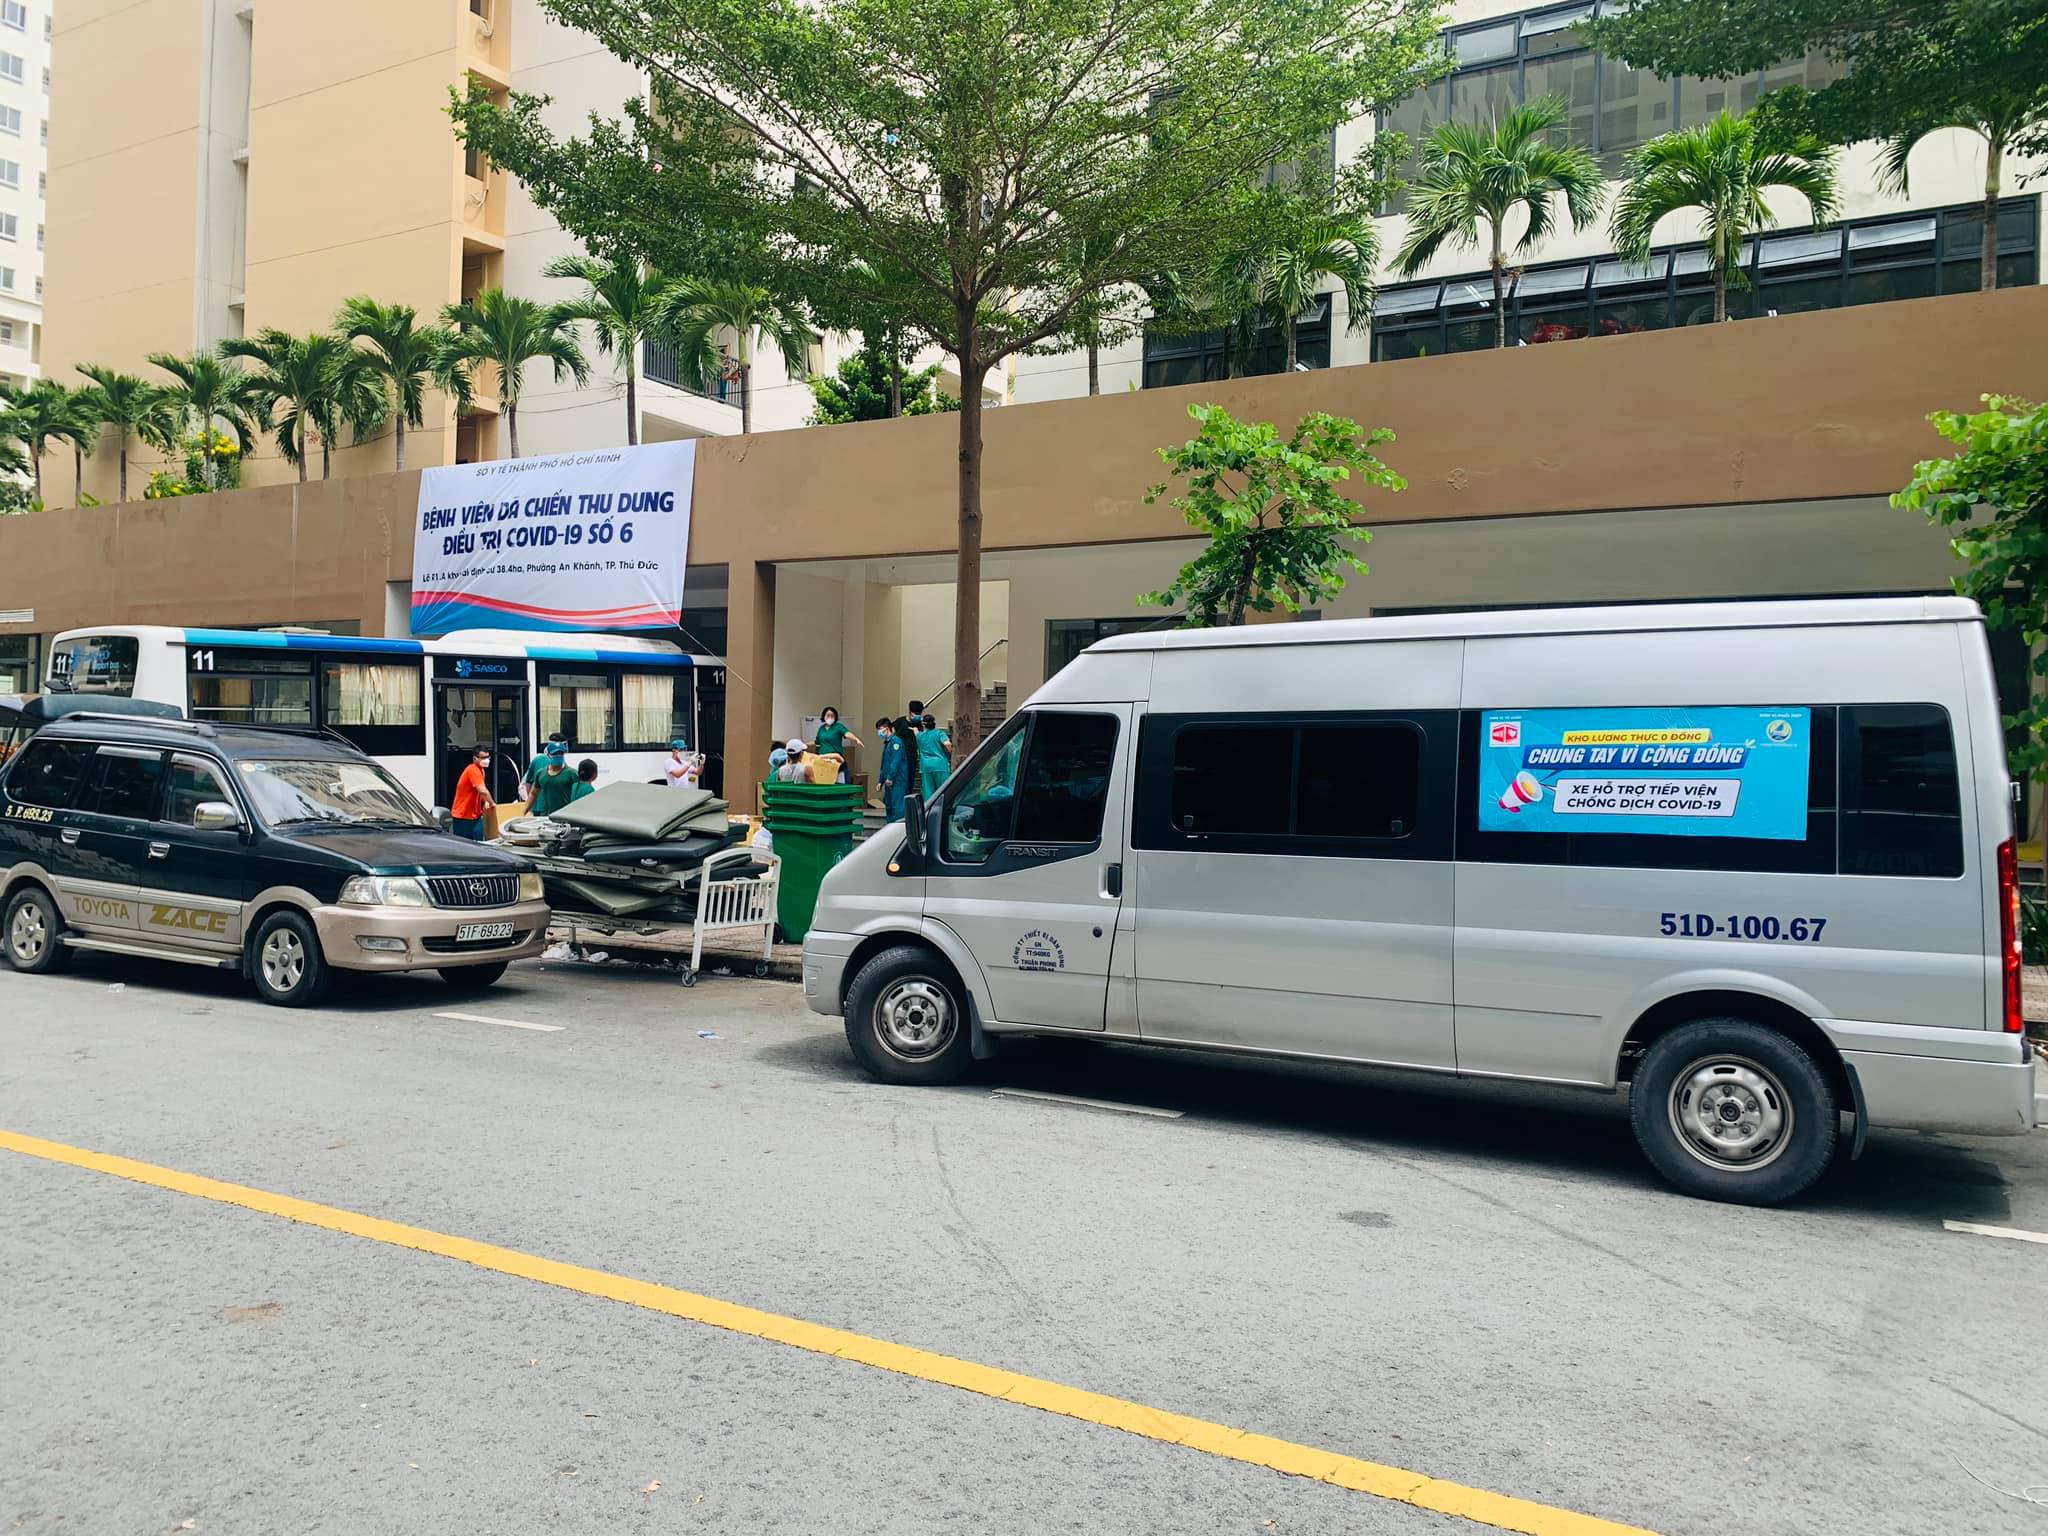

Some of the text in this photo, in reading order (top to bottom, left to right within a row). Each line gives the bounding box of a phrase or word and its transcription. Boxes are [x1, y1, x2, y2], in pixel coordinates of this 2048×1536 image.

[491, 466, 498, 476] Y
[596, 452, 622, 464] MINH
[422, 506, 457, 535] BỆNH
[461, 500, 495, 529] VIỆN
[524, 488, 572, 518] CHIẾN
[578, 493, 614, 515] THU
[617, 491, 675, 513] DUNG
[443, 515, 634, 556] ĐIỀU TRỊ COVID-19 SỐ 6
[559, 562, 570, 571] An
[605, 561, 617, 570] TP.
[619, 559, 635, 570] Thủ
[637, 560, 659, 570] Đức
[55, 655, 67, 674] 11
[192, 650, 215, 671] 11
[473, 664, 508, 673] SASCO
[712, 669, 725, 685] 11
[1567, 734, 1590, 743] KHO
[1527, 741, 1745, 767] CHUNG TAY VÌ CỘNG ĐỒNG
[1571, 780, 1718, 798] XE HỖ TRỢ TIẾP VIỆN
[1567, 794, 1722, 811] CHỐNG DỊCH COVID-19
[1006, 847, 1059, 857] TRANSIT
[73, 896, 229, 934] TOYOTA ZACE
[1660, 912, 1827, 942] 51D-100.67
